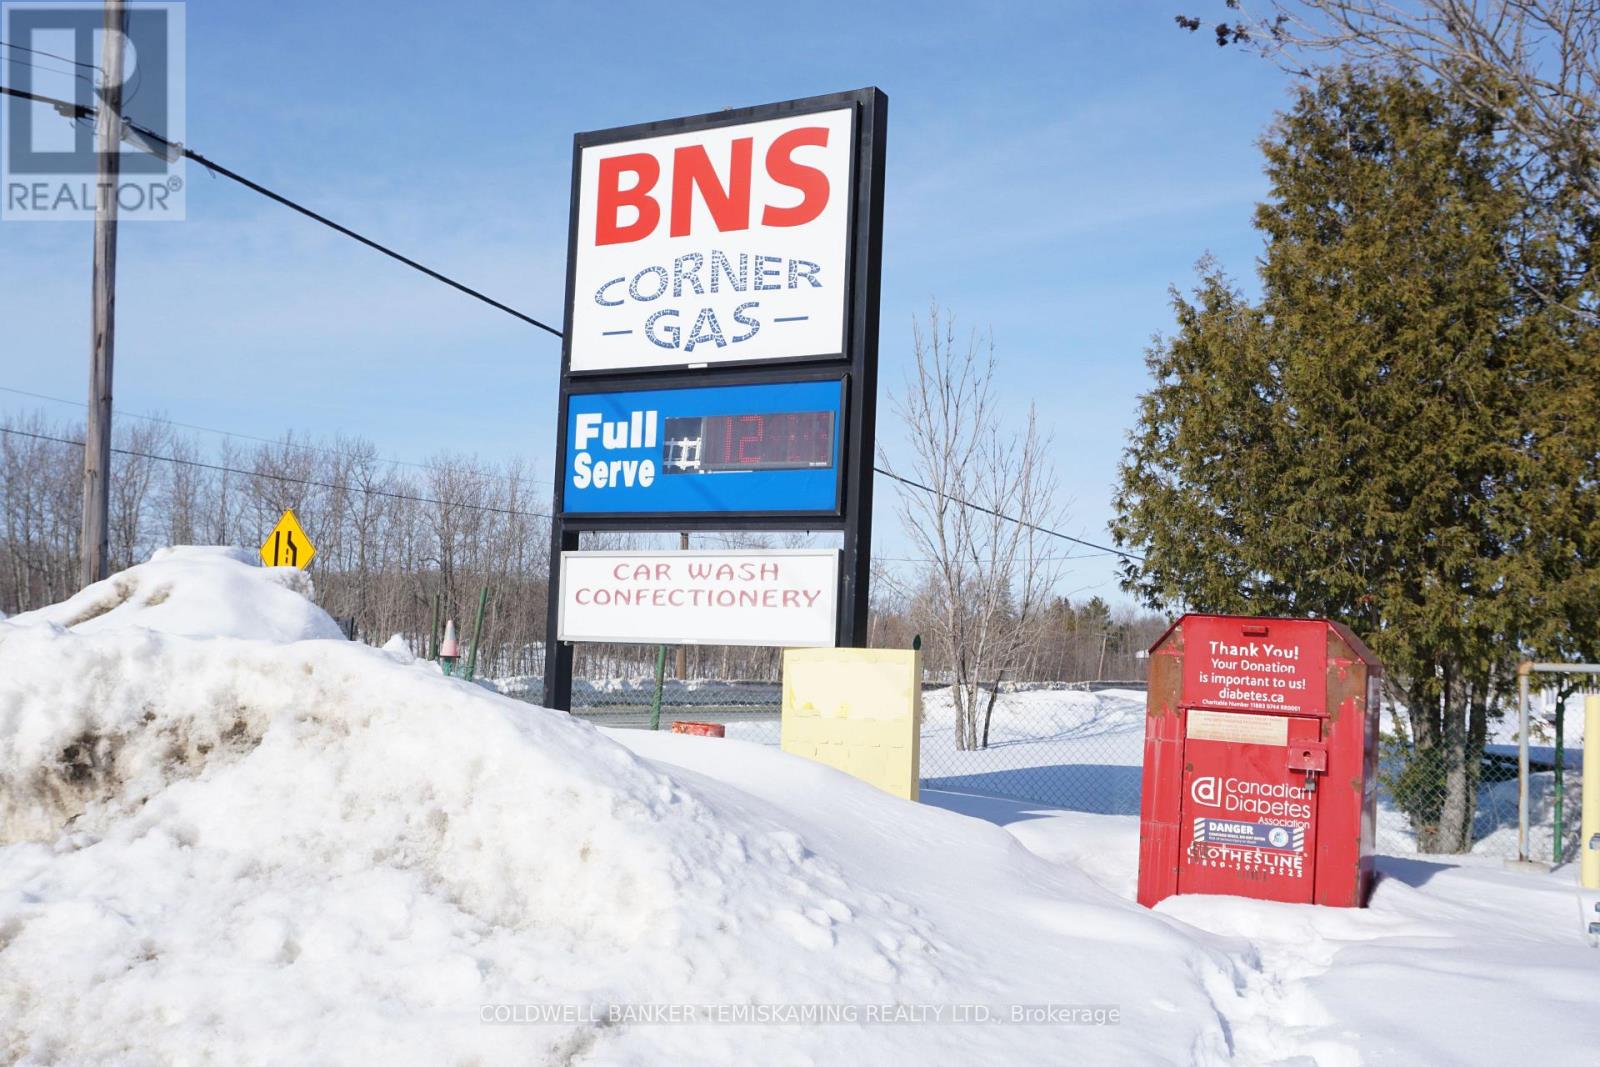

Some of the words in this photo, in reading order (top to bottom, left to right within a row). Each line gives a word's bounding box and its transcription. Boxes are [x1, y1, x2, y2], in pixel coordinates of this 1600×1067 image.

[595, 127, 830, 246] BNS
[595, 250, 823, 307] CORNER
[645, 302, 761, 352] GAS
[575, 410, 658, 450] Full
[573, 452, 656, 489] Serve
[613, 563, 672, 581] CAR
[688, 563, 779, 581] WASH
[575, 588, 822, 608] CONFECTIONERY
[1209, 641, 1259, 657] Thank
[1263, 644, 1299, 660] You!
[1211, 658, 1238, 670] Your
[1241, 660, 1295, 674] Donation
[1199, 671, 1208, 683] is
[1211, 672, 1270, 687] important
[1273, 678, 1286, 688] to
[1288, 679, 1306, 690] us!
[1202, 699, 1228, 707] Charitable
[1218, 688, 1284, 703] diabetes.ca
[1225, 778, 1312, 800] Canadian
[1225, 794, 1311, 819] Diabetes
[1208, 822, 1254, 835] DANGER
[1257, 816, 1311, 830] Association
